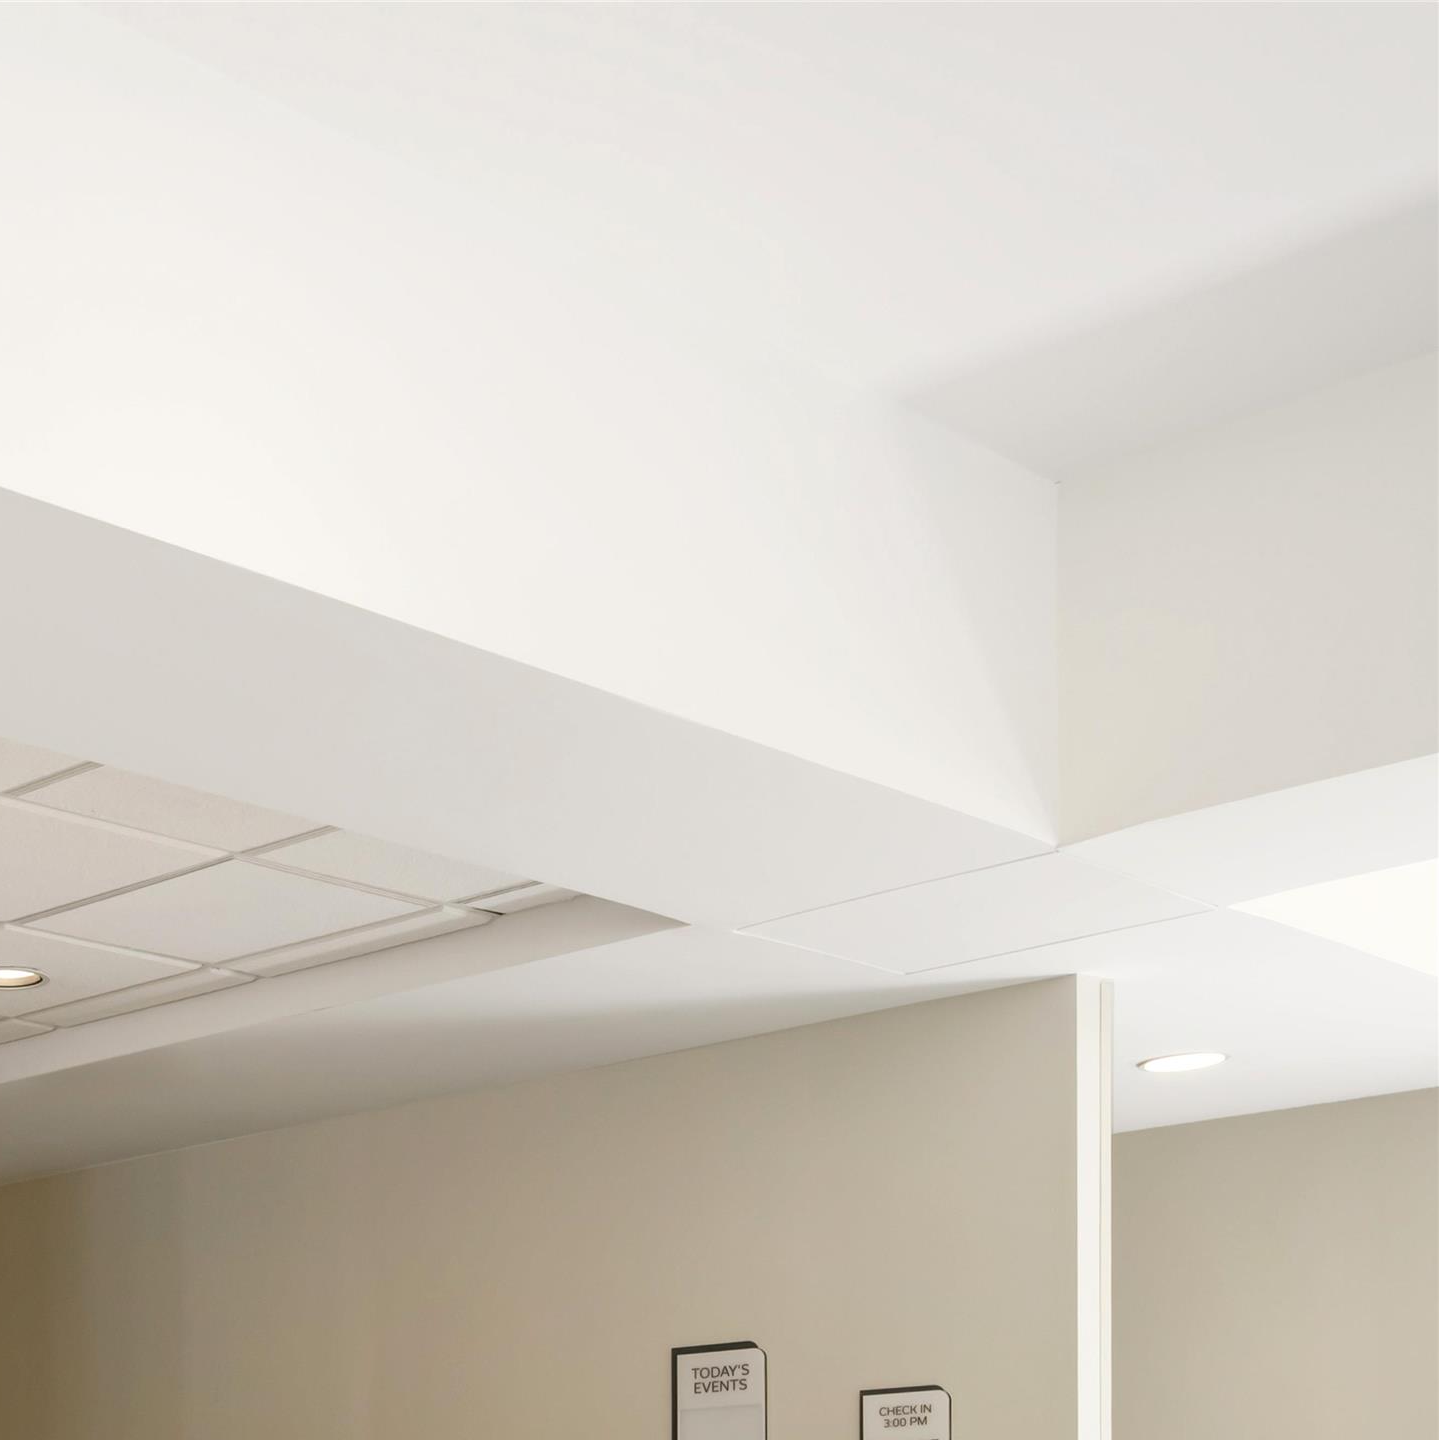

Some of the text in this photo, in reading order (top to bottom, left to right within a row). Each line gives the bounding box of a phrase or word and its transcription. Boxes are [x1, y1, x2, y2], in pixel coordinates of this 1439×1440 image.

[691, 1363, 750, 1380] TODAY'S
[693, 1378, 748, 1394] EVENTS
[878, 1403, 932, 1417] CHECK IN
[883, 1416, 928, 1428] 3:00 PM
